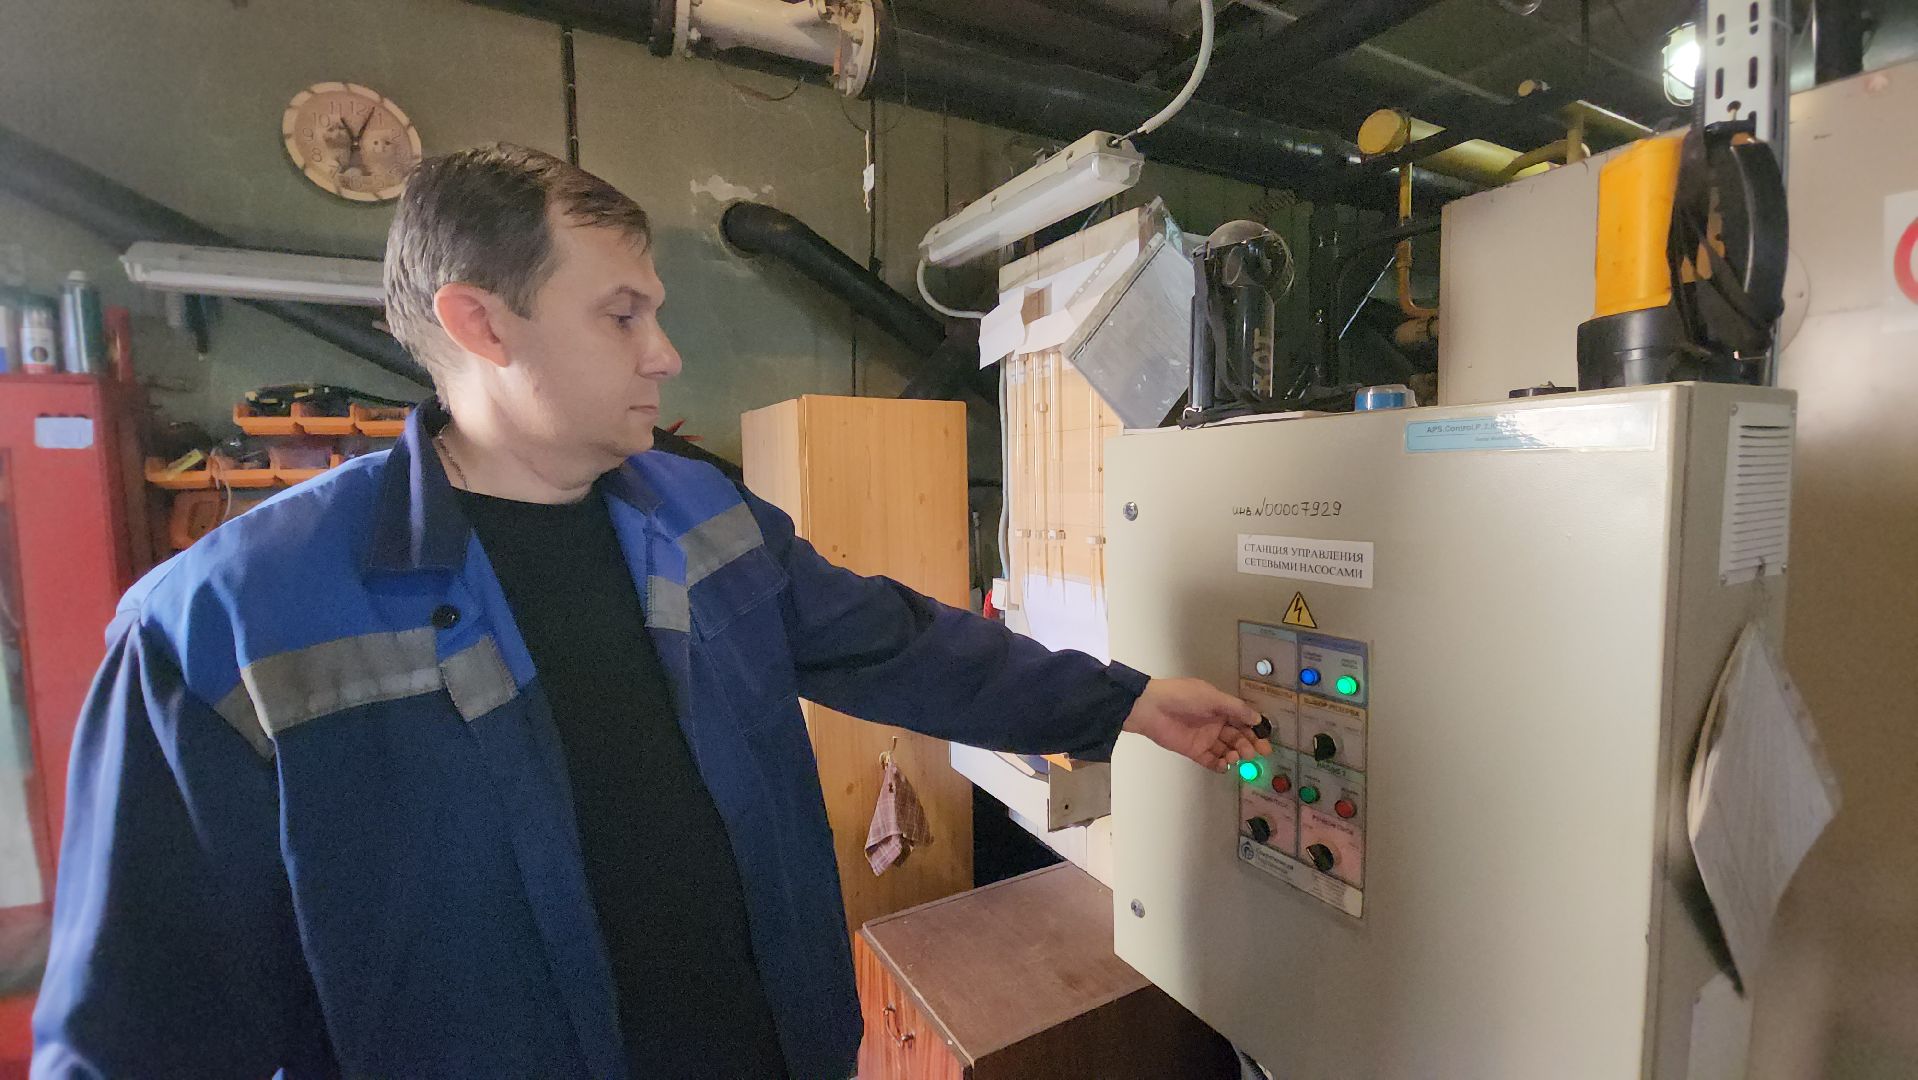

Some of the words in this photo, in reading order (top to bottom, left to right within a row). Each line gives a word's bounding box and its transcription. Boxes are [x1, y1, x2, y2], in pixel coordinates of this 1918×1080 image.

[349, 101, 369, 116] 12
[312, 111, 331, 128] 10
[302, 127, 314, 141] 9
[311, 147, 323, 163] 8
[1244, 543, 1289, 556] СТАНЦИЯ
[1291, 547, 1364, 564] УПРАВЛЕНИЯ
[1244, 557, 1298, 572] СЕТЕВЫМИ
[1299, 562, 1363, 579] НАСОСАМИ
